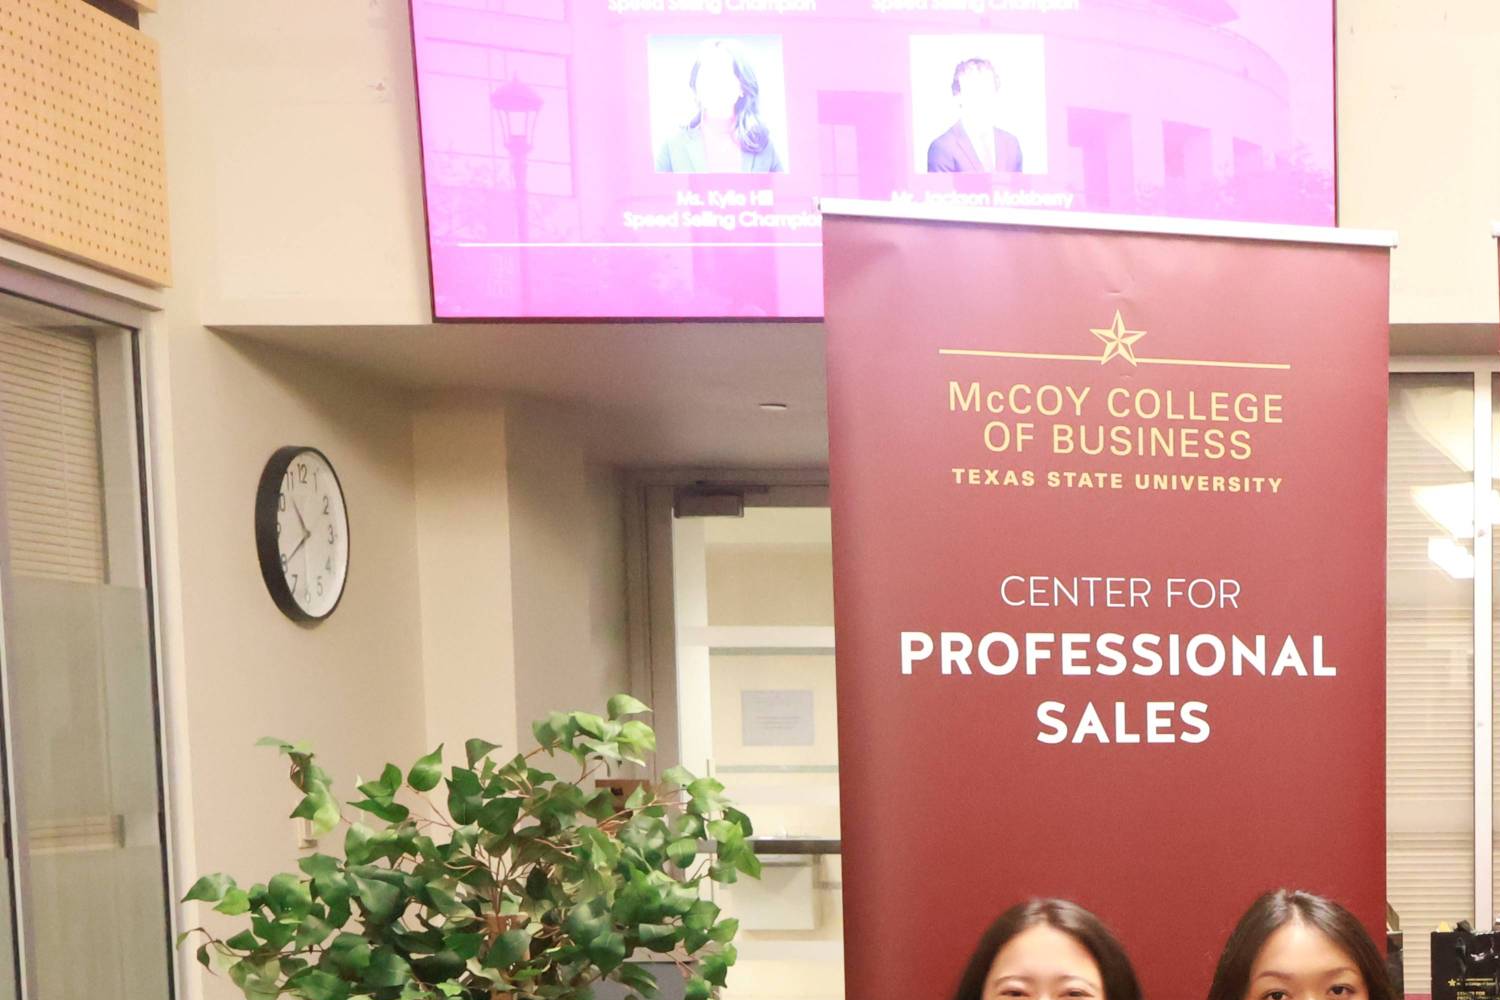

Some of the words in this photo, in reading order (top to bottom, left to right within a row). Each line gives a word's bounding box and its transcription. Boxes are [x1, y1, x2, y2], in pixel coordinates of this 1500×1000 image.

[708, 191, 745, 208] Kylie
[752, 190, 774, 206] Hill
[624, 211, 679, 230] Speed
[682, 211, 735, 231] Selling
[948, 381, 1090, 416] McCOY
[1107, 387, 1284, 424] COLLEGE
[984, 421, 1034, 453] OF
[1052, 424, 1252, 461] BUSINESS
[297, 464, 307, 483] 12
[952, 468, 1035, 488] TEXAS
[1047, 471, 1124, 490] STATE
[1135, 474, 1283, 494] UNIVERSITY
[323, 496, 329, 515] 2
[328, 525, 334, 544] 3
[291, 575, 299, 595] 7
[317, 576, 323, 597] 5
[1000, 576, 1152, 608] CENTER
[1167, 579, 1241, 609] FOR
[900, 632, 1337, 677] PROFESSIONAL
[1036, 701, 1211, 744] SALES
